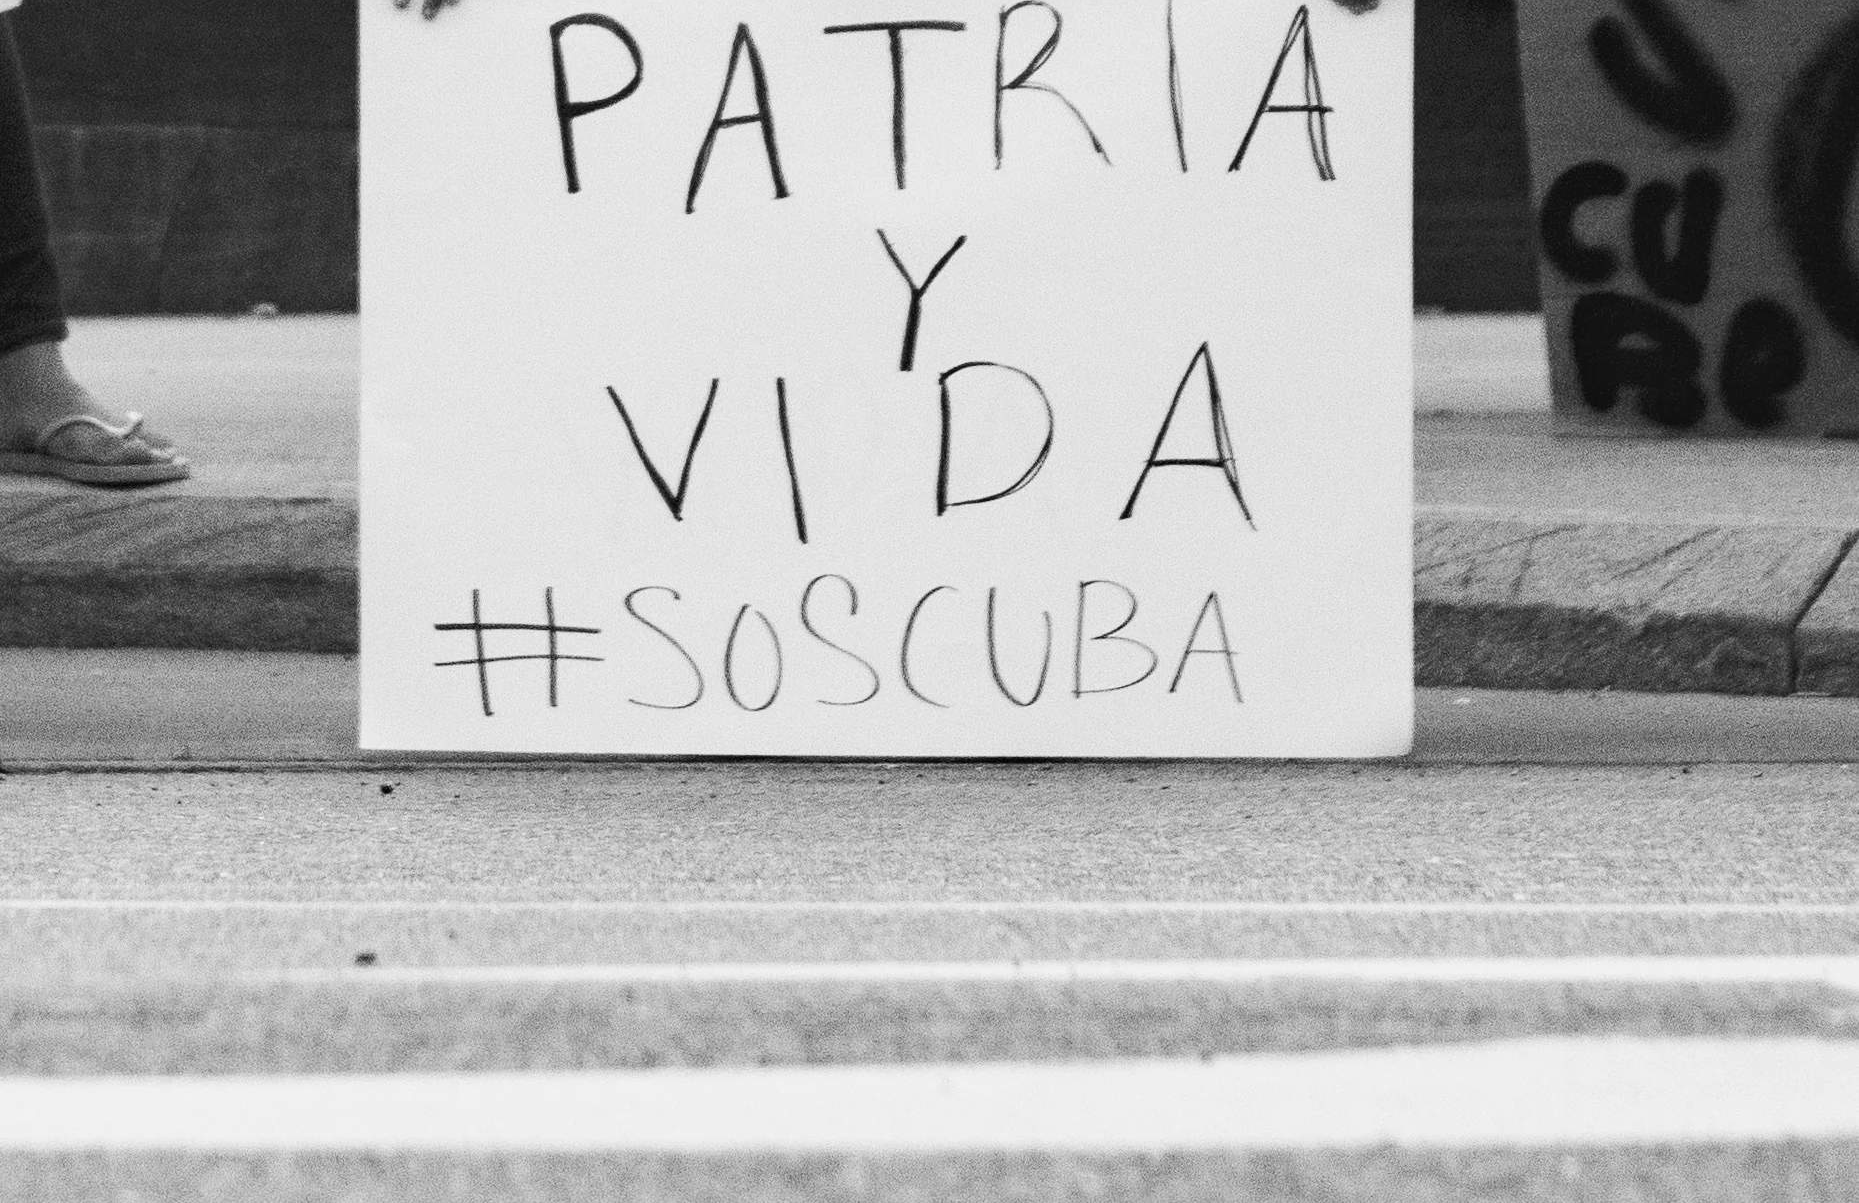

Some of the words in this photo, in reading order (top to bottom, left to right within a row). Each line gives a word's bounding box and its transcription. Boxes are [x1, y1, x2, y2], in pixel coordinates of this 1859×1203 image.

[876, 228, 967, 371] Y
[607, 341, 1255, 542] VIDA
[435, 574, 1243, 716] #SOSCUBA
